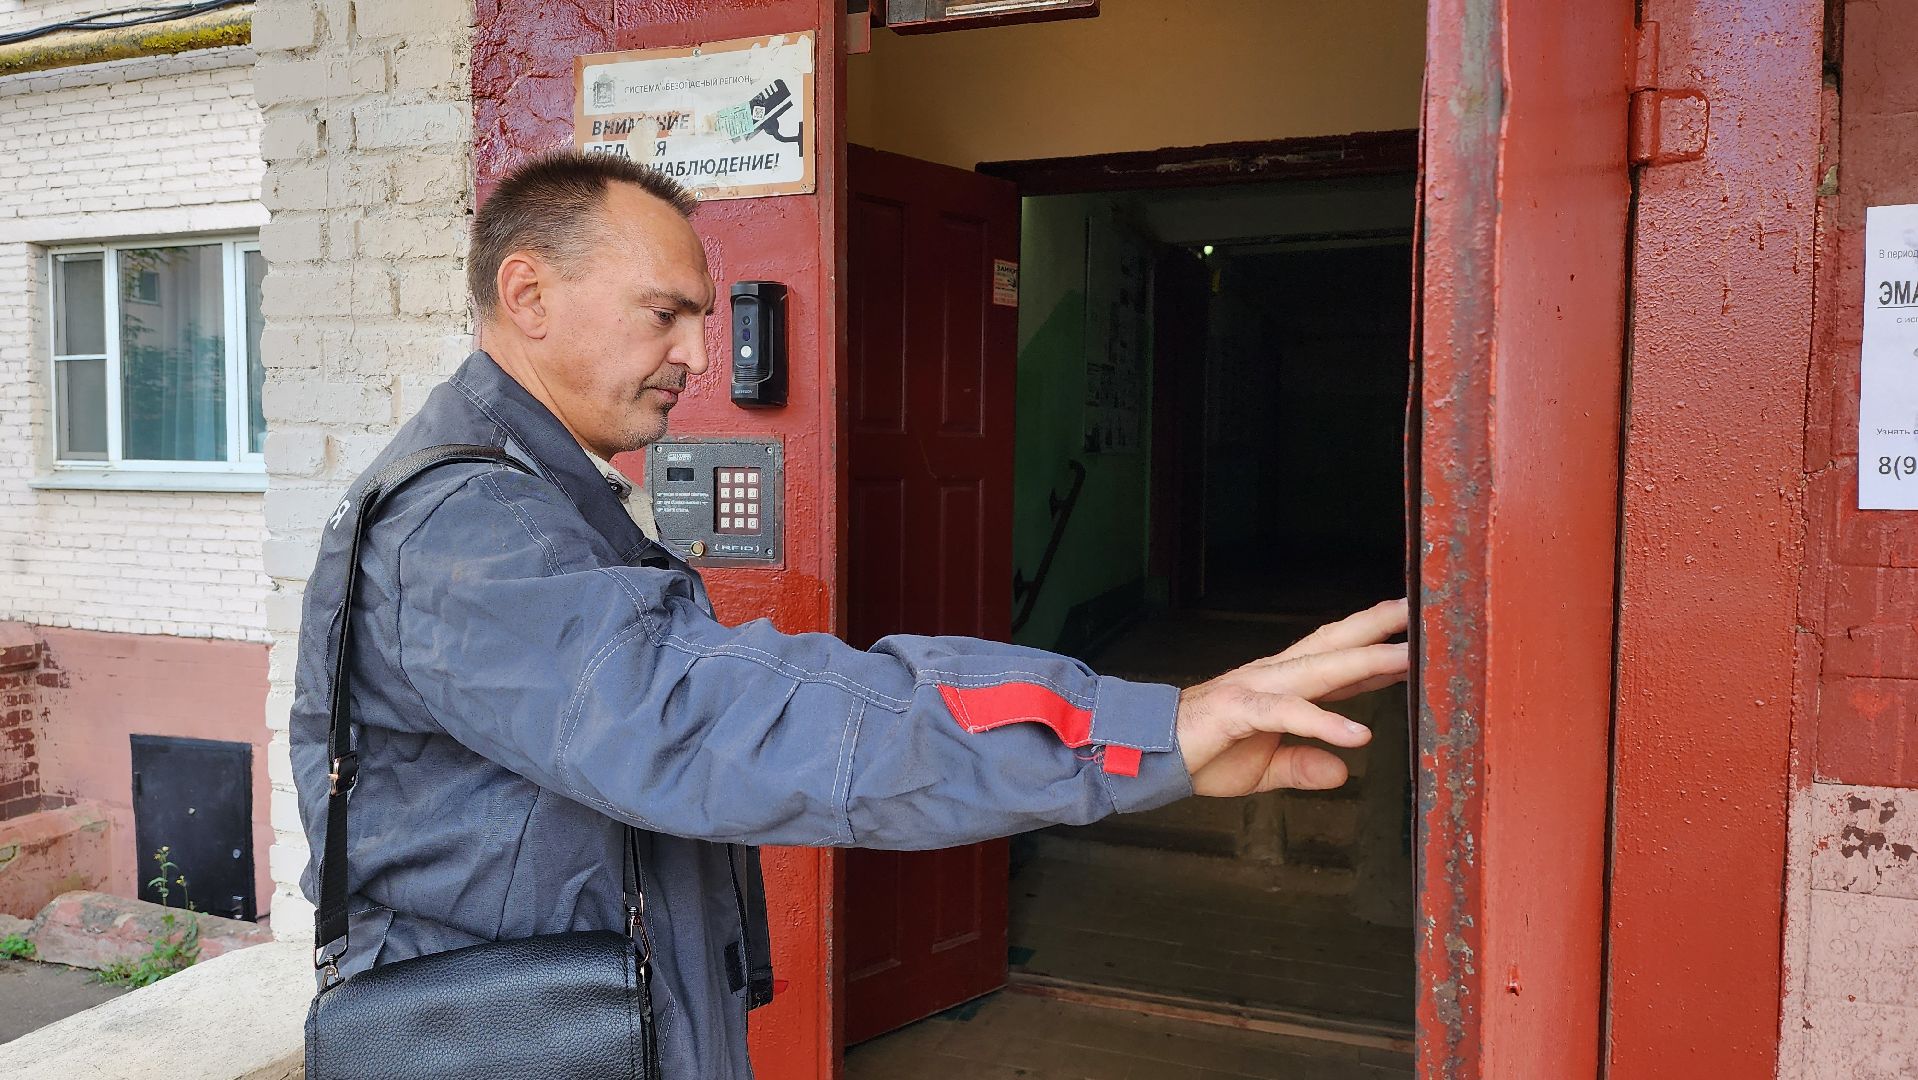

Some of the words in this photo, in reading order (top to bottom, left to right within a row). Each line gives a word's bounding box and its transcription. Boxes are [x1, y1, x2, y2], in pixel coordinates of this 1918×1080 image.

[592, 114, 690, 136] ВНИМНИЕ
[1879, 249, 1885, 258] В
[1878, 455, 1917, 481] 8(9
